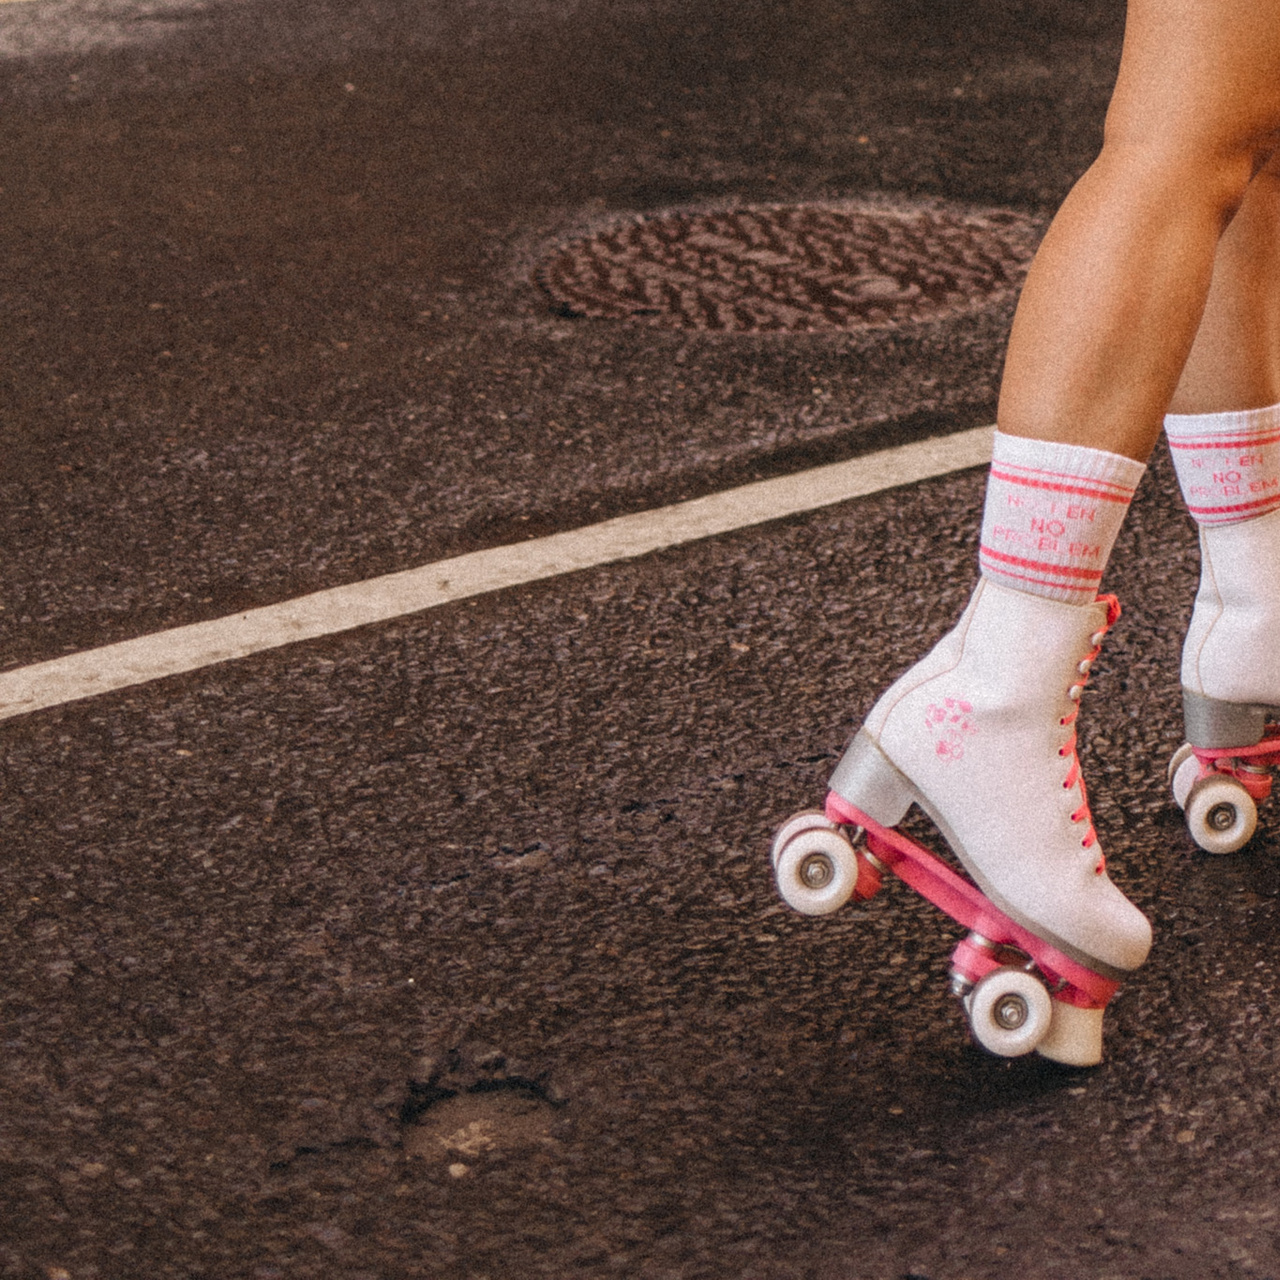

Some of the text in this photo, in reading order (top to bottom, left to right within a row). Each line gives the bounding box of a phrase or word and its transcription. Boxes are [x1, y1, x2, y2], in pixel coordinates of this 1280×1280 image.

[1225, 453, 1264, 468] EN
[1189, 476, 1279, 497] PRBLEM
[1212, 470, 1242, 485] NO
[1050, 501, 1096, 523] EN
[1030, 517, 1066, 538] NO
